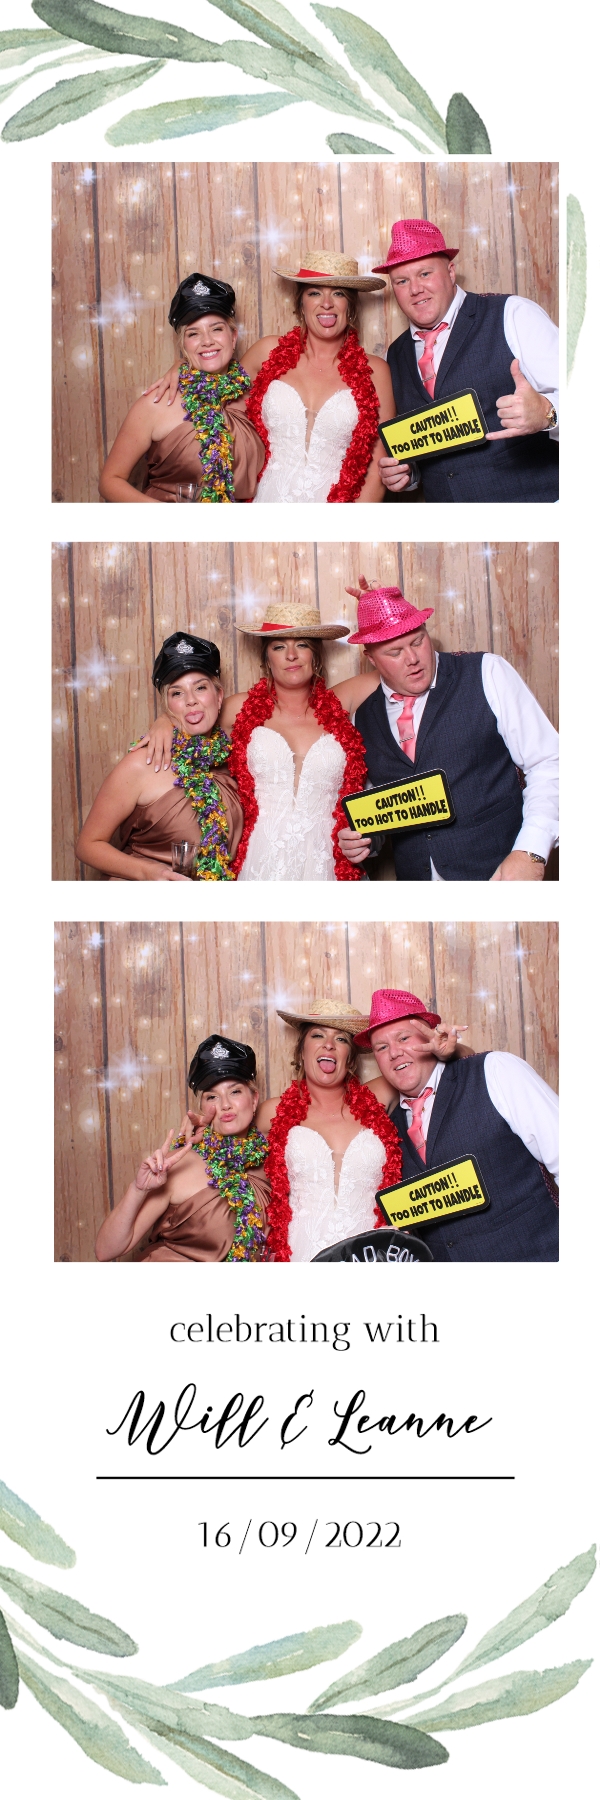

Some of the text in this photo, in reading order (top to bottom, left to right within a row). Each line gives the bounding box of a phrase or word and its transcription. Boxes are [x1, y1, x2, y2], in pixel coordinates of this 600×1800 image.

[410, 406, 459, 434] CAUTION!!
[391, 442, 411, 454] TOO
[410, 436, 429, 450] HOT
[429, 432, 443, 444] TO
[442, 418, 481, 442] HANDLE
[375, 785, 427, 810] CAUTION!!
[355, 799, 448, 828] TOO HOT TO HANDLE
[409, 1172, 459, 1201] CAUTION!!
[390, 1184, 482, 1222] TOO HOT TO HANDLE
